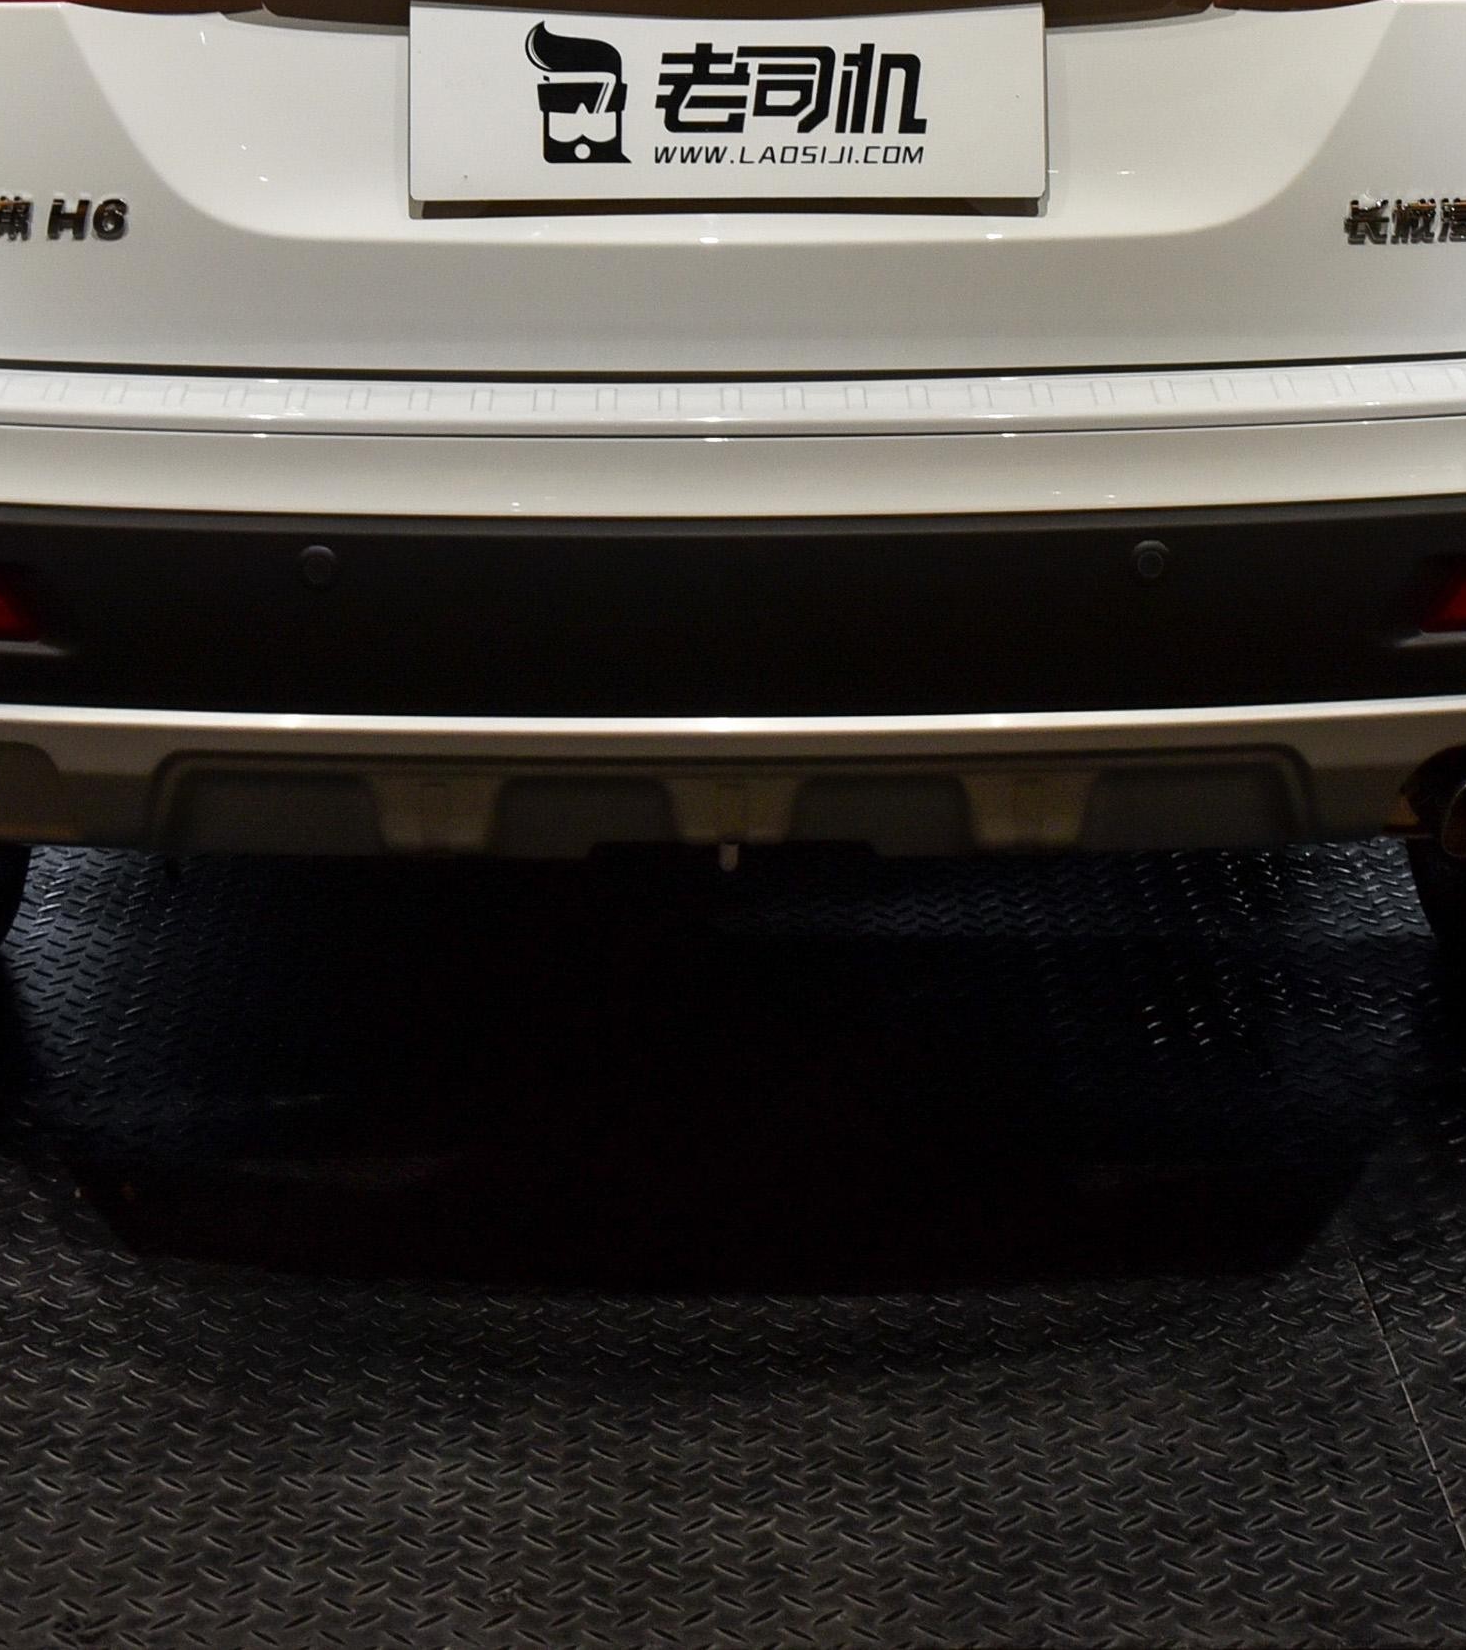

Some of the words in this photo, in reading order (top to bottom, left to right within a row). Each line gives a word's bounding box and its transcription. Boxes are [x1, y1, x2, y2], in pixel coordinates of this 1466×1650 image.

[654, 43, 928, 134] 老司机
[653, 145, 925, 165] WWW.LAOSIJI.COM
[47, 198, 129, 241] H6
